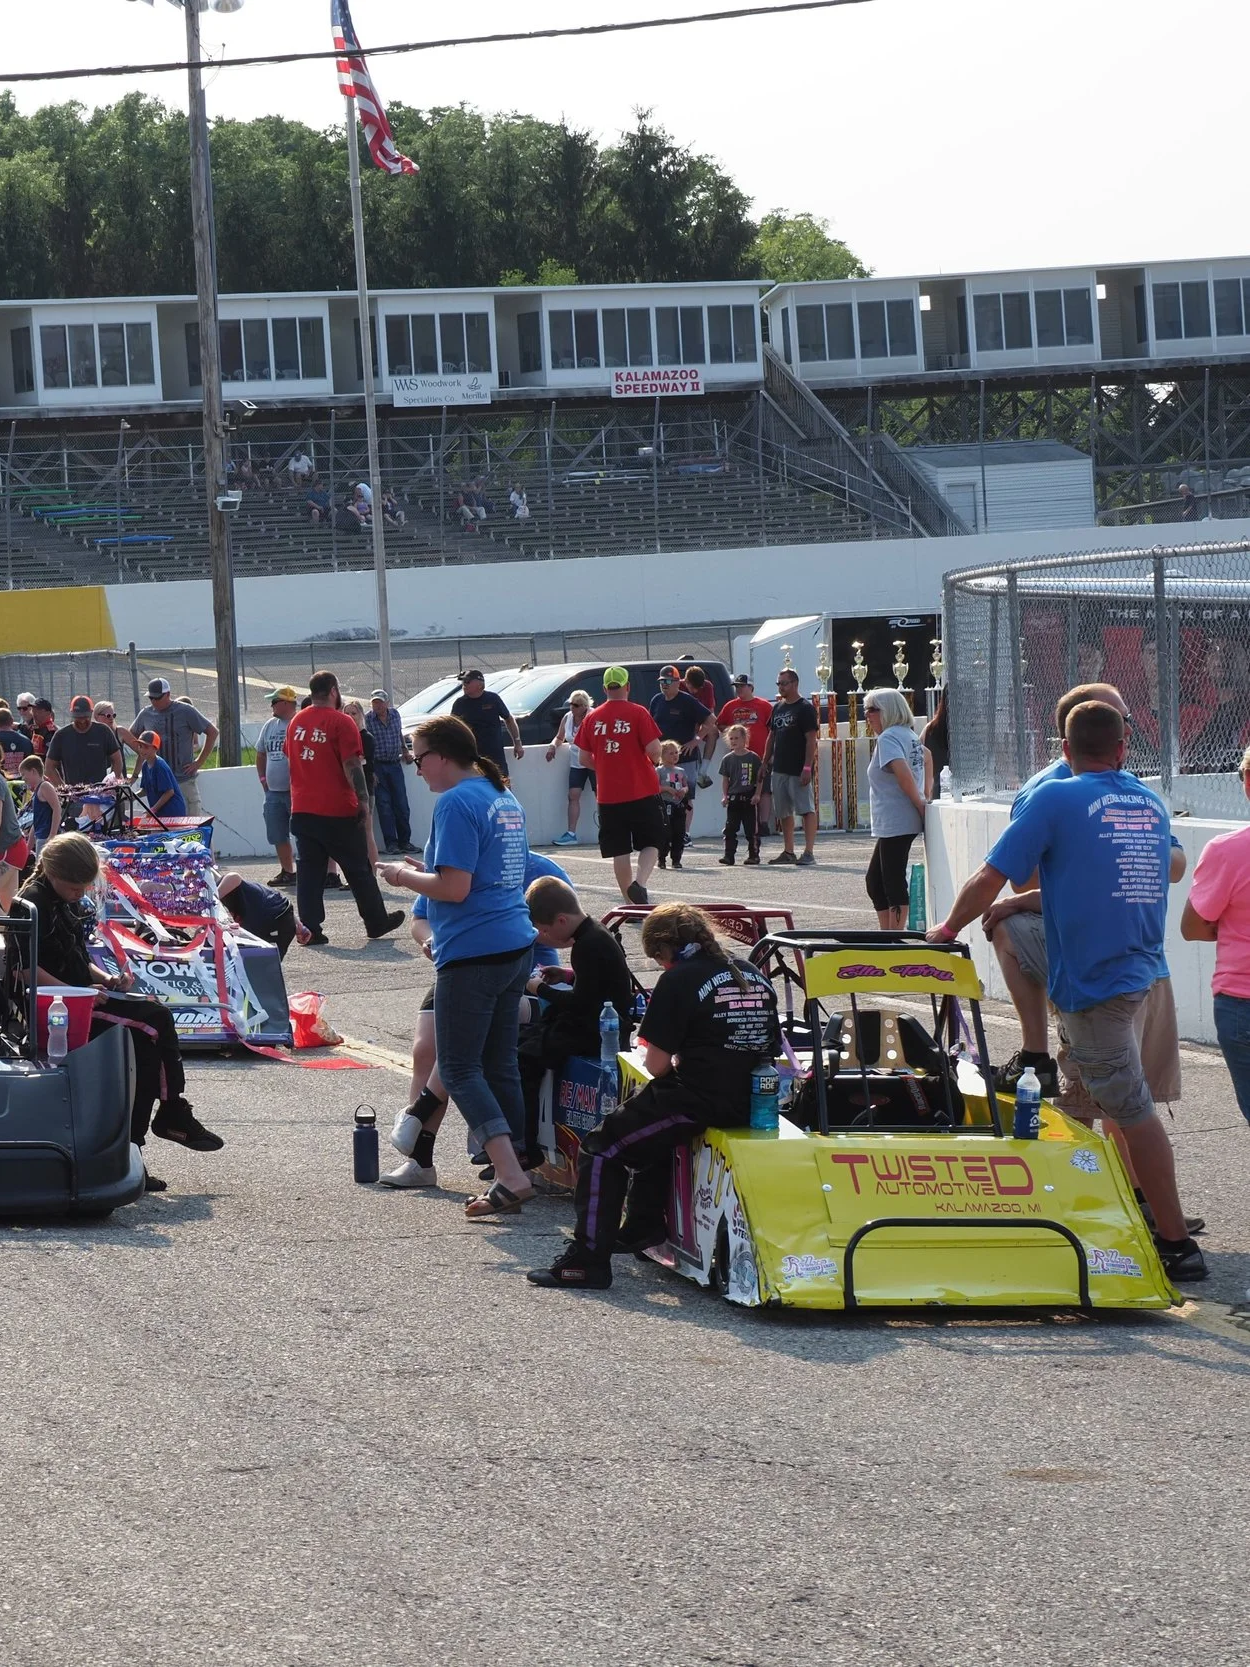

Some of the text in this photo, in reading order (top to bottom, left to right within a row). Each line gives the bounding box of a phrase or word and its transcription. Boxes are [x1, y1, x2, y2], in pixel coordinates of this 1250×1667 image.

[420, 378, 462, 388] Woodwork
[614, 369, 699, 383] KALAMAZOO
[614, 381, 701, 395] SPEEDWAY II
[403, 394, 443, 405] Specialties
[461, 391, 488, 400] Merillat
[1107, 608, 1142, 619] THE
[1202, 609, 1223, 620] OF
[594, 720, 631, 736] 71 35
[293, 727, 327, 744] 71 35
[300, 747, 315, 761] 42
[605, 740, 620, 754] 42
[1120, 794, 1146, 805] RACING
[837, 963, 955, 982] Ella Terry
[698, 980, 713, 1002] MINI
[711, 971, 733, 987] WEDGE
[559, 1079, 598, 1115] RE/MAX
[831, 1154, 1034, 1195] TWISTED
[875, 1181, 996, 1196] AUTOMOTIVE
[934, 1203, 1042, 1215] KALAMAZOO, MI
